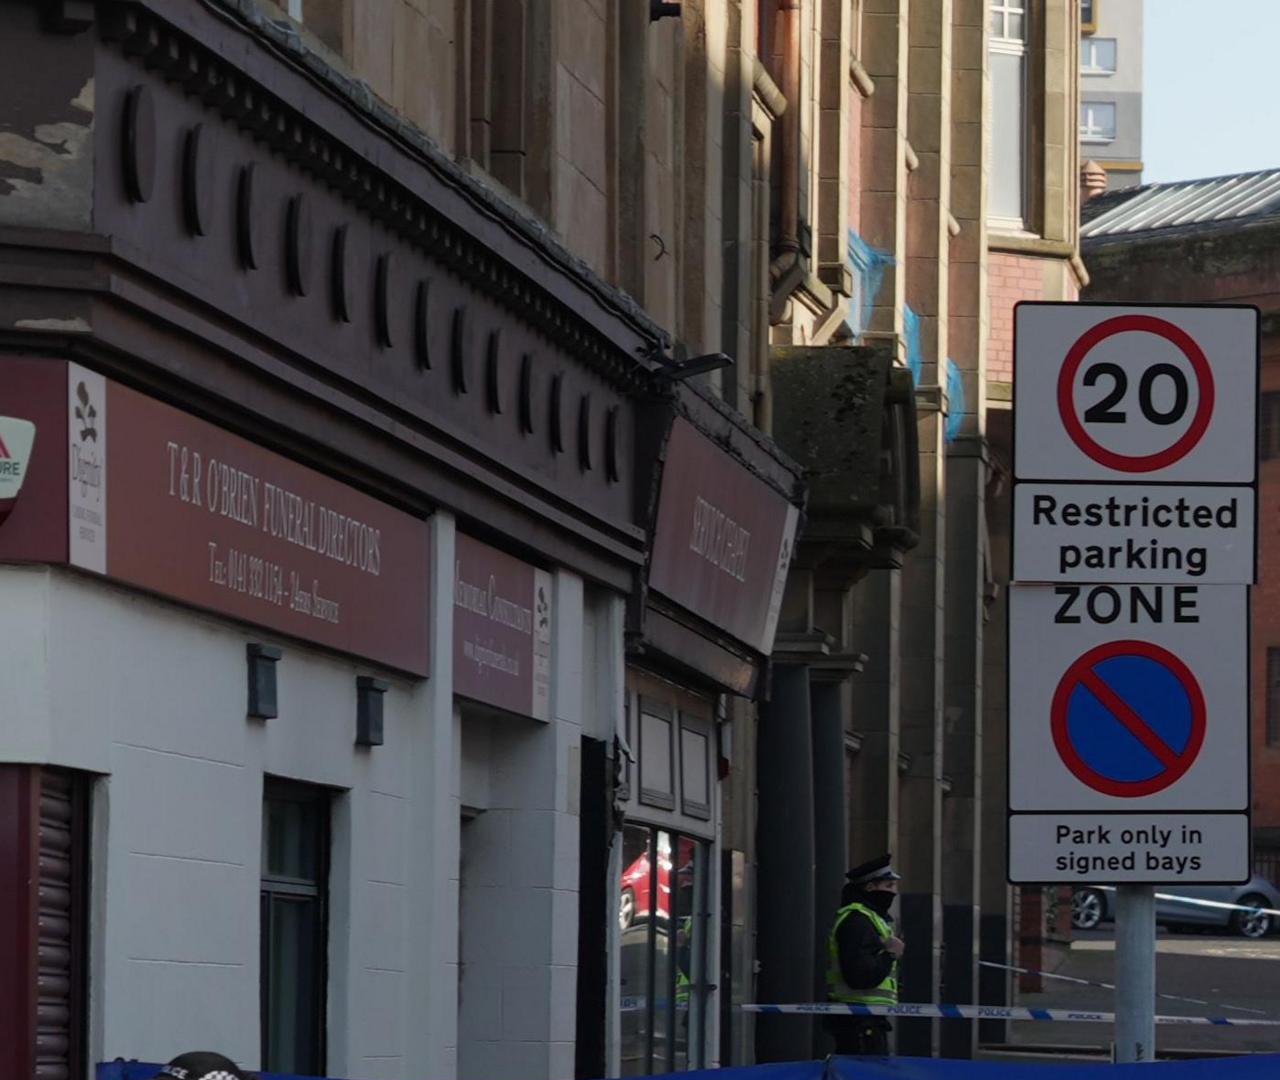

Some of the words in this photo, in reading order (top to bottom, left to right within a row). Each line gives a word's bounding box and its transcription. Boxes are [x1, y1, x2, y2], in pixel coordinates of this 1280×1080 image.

[1082, 362, 1190, 425] 20
[166, 441, 178, 496] T
[180, 446, 190, 502] &
[191, 451, 202, 506] R
[206, 459, 259, 527] O'BRIEN
[262, 482, 317, 552] FUNERAL
[318, 505, 381, 577] DIRECTORS
[1032, 495, 1239, 529] Restricted
[1058, 538, 1208, 577] parking
[1053, 586, 1201, 625] ZONE
[1055, 826, 1111, 845] Park
[1120, 825, 1172, 850] only
[1181, 825, 1203, 844] in
[1056, 851, 1136, 876] signed
[1145, 851, 1202, 876] bays
[886, 1005, 922, 1015] POLICE
[977, 1007, 1012, 1017] POLICE
[1067, 1013, 1105, 1021] POLICE
